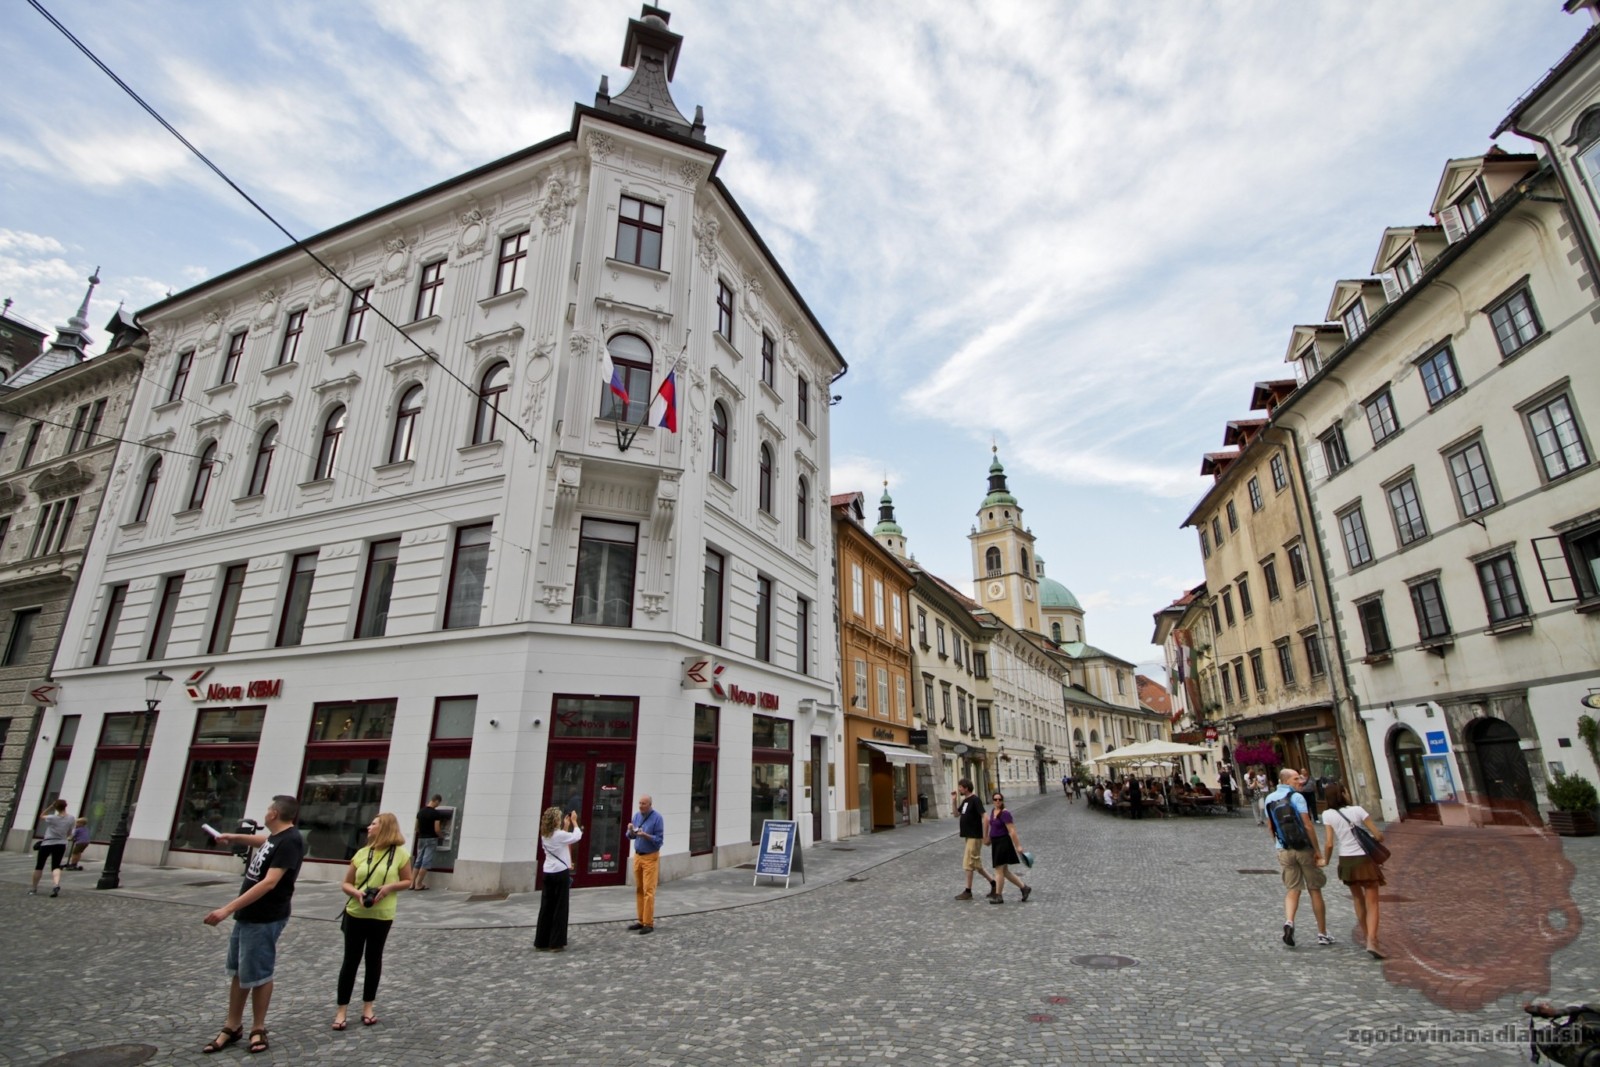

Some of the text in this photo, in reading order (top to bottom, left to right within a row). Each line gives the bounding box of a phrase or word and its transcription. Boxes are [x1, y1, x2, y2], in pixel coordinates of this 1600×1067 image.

[207, 679, 283, 701] Nova KBM
[728, 684, 779, 710] Nova KBM
